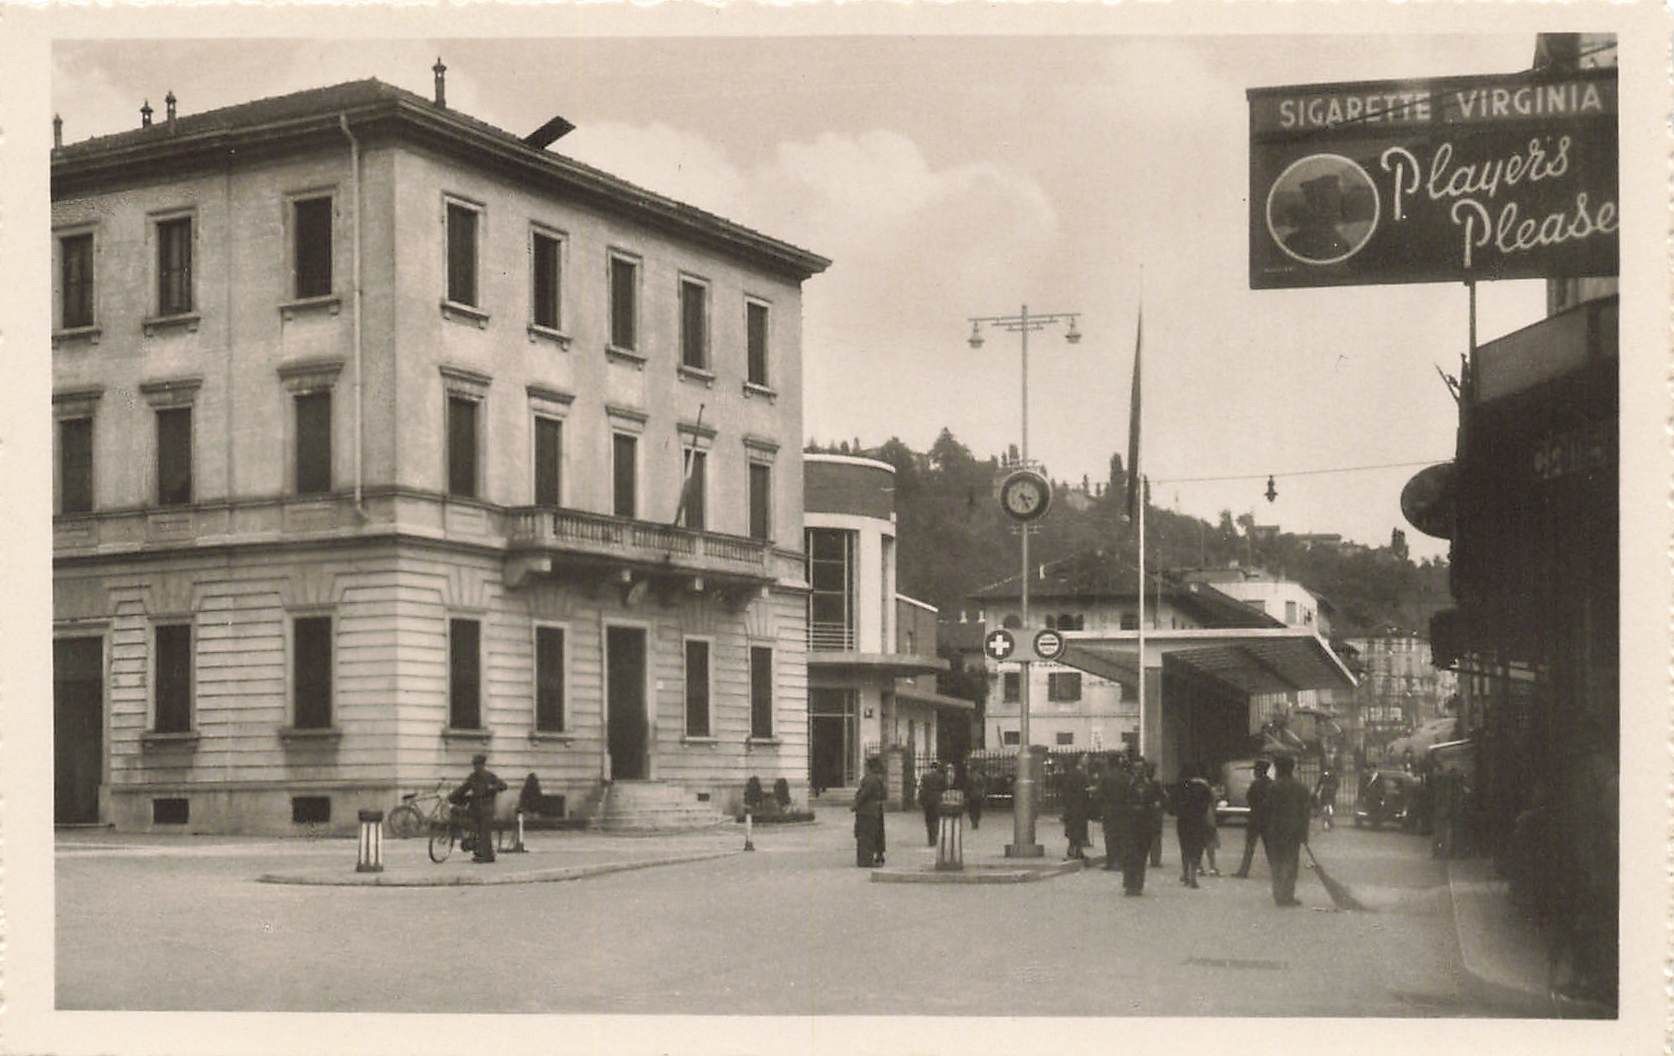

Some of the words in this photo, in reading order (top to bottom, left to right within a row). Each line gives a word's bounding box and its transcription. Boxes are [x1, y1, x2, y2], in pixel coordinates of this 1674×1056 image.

[1279, 92, 1431, 128] SIGARETTE
[1456, 82, 1603, 118] VIRGINIA
[1381, 135, 1571, 220] Player's
[1451, 192, 1618, 268] Please
